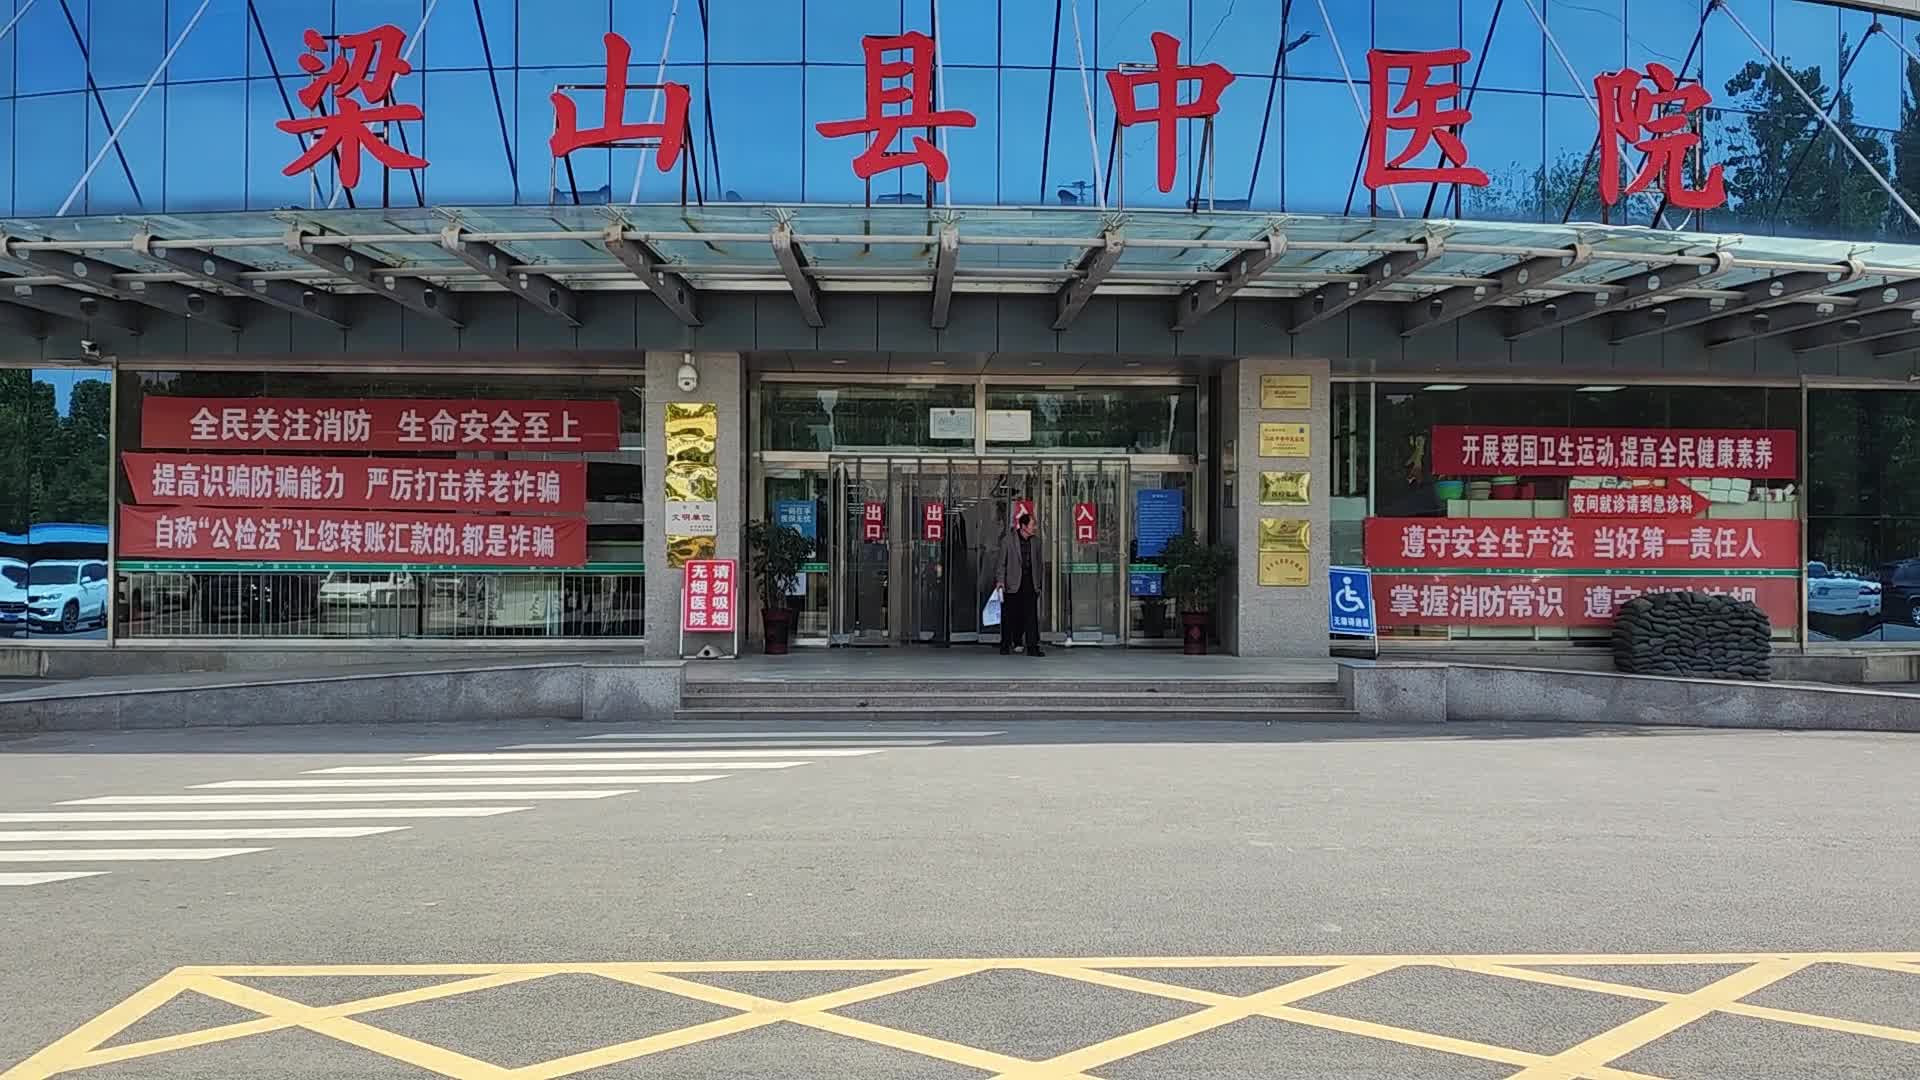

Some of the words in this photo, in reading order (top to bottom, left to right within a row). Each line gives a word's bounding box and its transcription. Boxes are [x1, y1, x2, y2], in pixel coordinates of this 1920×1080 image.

[276, 24, 1726, 210] 梁山县中医院
[190, 408, 372, 442] 全民关注消防
[398, 409, 582, 443] 生命安全至上
[152, 463, 345, 500] 提高识骗防骗能力
[366, 467, 560, 504] 严厉打击养老诈骗
[672, 513, 711, 521] 文明单位
[866, 504, 882, 538] 出口
[927, 504, 942, 538] 出口
[1573, 494, 1693, 514] 夜间就诊请到急诊科
[1077, 505, 1094, 539] 入口
[1402, 525, 1575, 559] 遵守安全生产法
[1593, 526, 1762, 560] 当好第一责任人
[690, 564, 708, 626] 无烟医院
[712, 564, 730, 626] 请勿吸烟
[1390, 583, 1565, 618] 掌握消防常识
